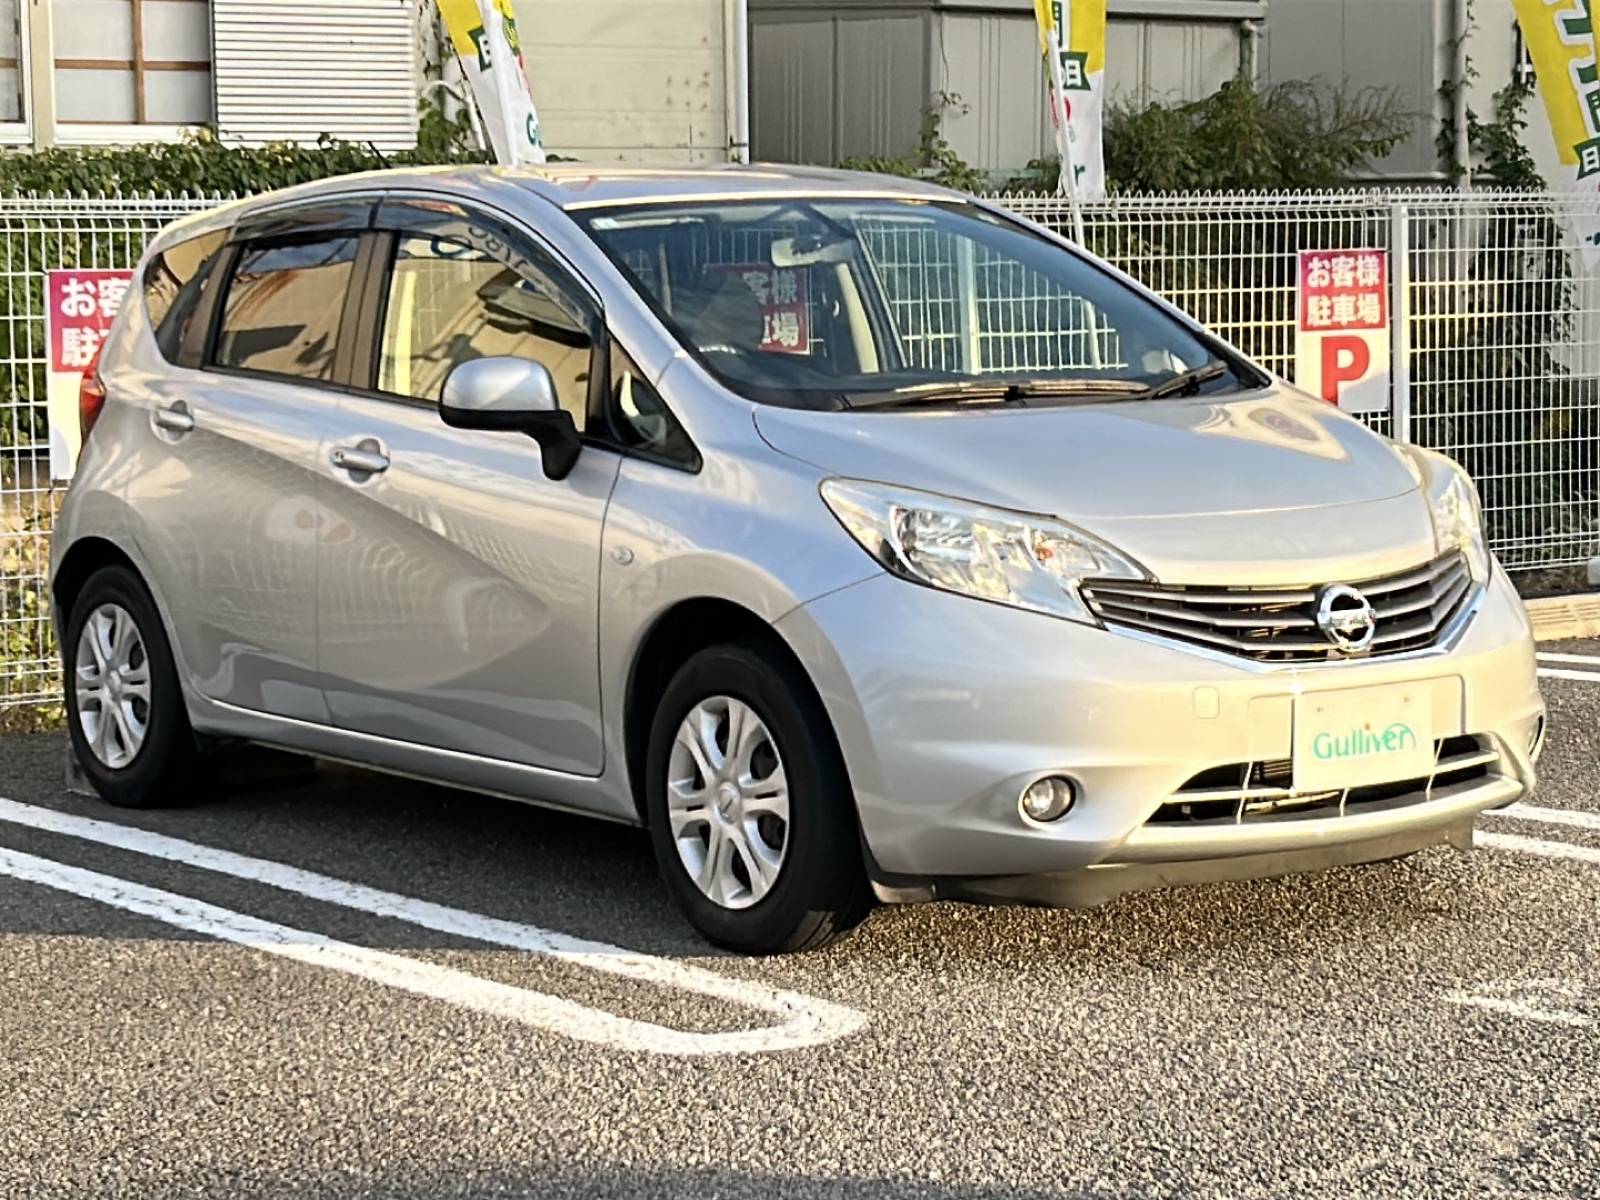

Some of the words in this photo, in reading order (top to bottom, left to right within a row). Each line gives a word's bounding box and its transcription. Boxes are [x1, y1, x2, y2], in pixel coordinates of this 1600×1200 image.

[1307, 255, 1380, 288] お客様
[60, 277, 131, 318] お客
[1307, 293, 1380, 327] 駐車場
[1320, 335, 1370, 408] P
[1312, 722, 1418, 760] Gulliver
